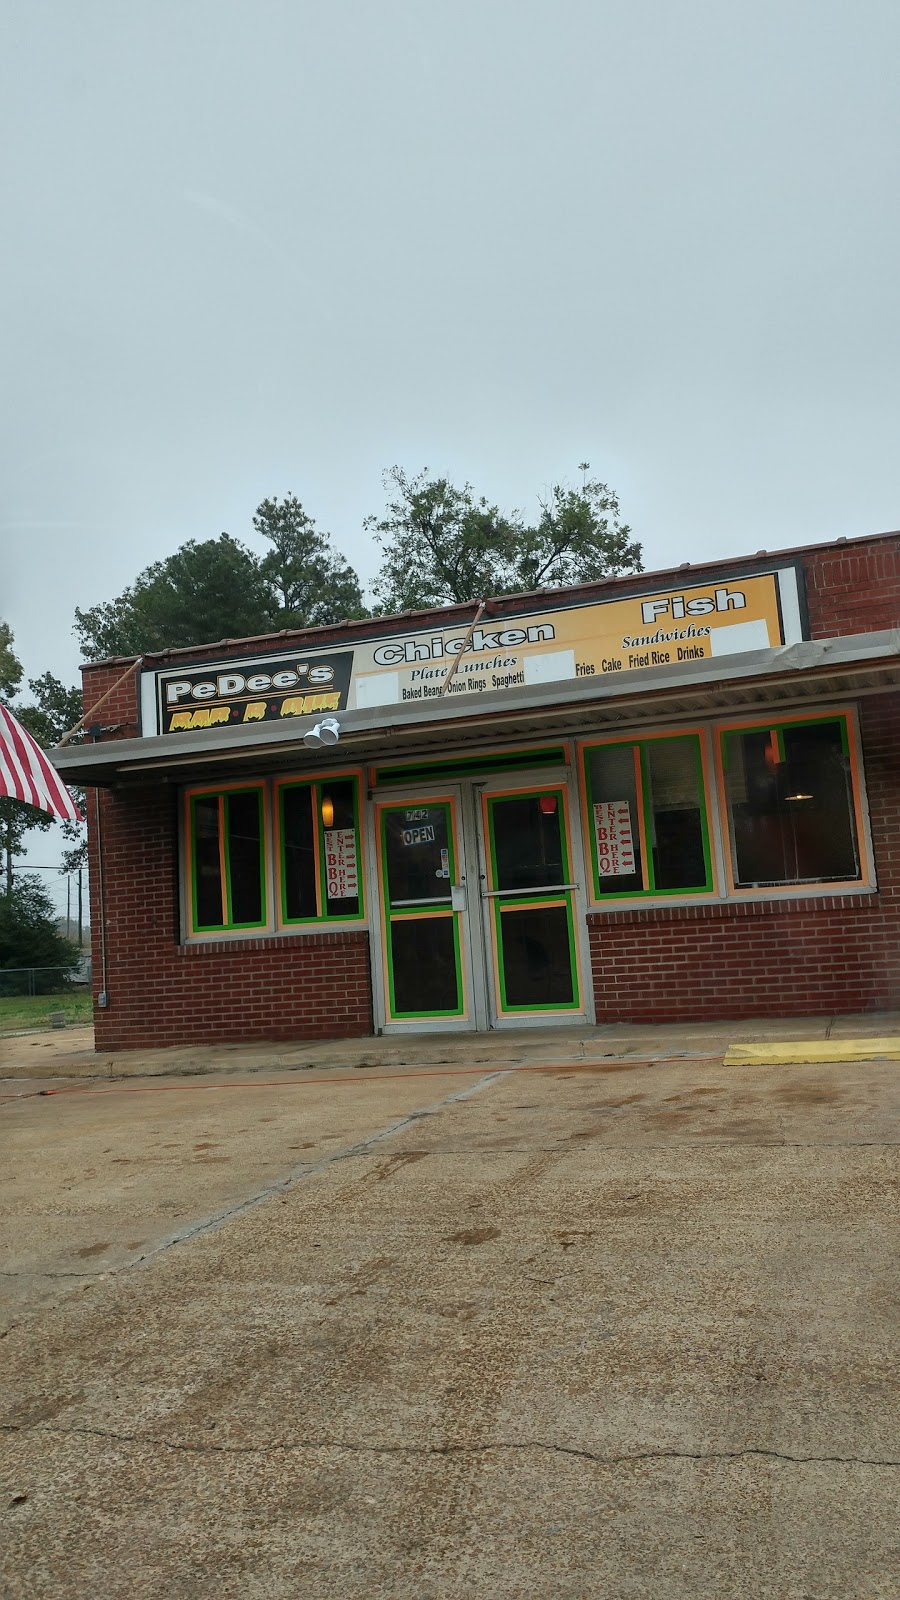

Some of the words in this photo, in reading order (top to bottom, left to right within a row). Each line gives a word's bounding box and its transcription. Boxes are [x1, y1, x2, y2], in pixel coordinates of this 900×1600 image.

[641, 588, 747, 624] Fish
[373, 623, 555, 666] Chicken
[621, 623, 712, 649] Sandwiches
[410, 666, 448, 682] Plate
[454, 654, 518, 675] Lunches
[575, 663, 595, 677] Fries
[601, 658, 622, 673] Cake
[628, 652, 650, 669] Fried
[651, 651, 670, 665] Rice
[677, 645, 704, 661] Drinks
[166, 663, 335, 704] PeDee's
[402, 685, 422, 700] Baked
[448, 678, 467, 693] Onion
[467, 677, 487, 692] Rings
[491, 671, 525, 688] Spaghetti
[406, 809, 428, 820] 742
[595, 804, 604, 826] BEST
[607, 803, 618, 841] ENTER
[336, 831, 346, 866] ENTER
[404, 826, 434, 844] OPEN
[597, 827, 611, 873] BBQ
[327, 853, 339, 896] BBQ
[610, 844, 620, 874] HERE
[338, 869, 347, 897] HERE
